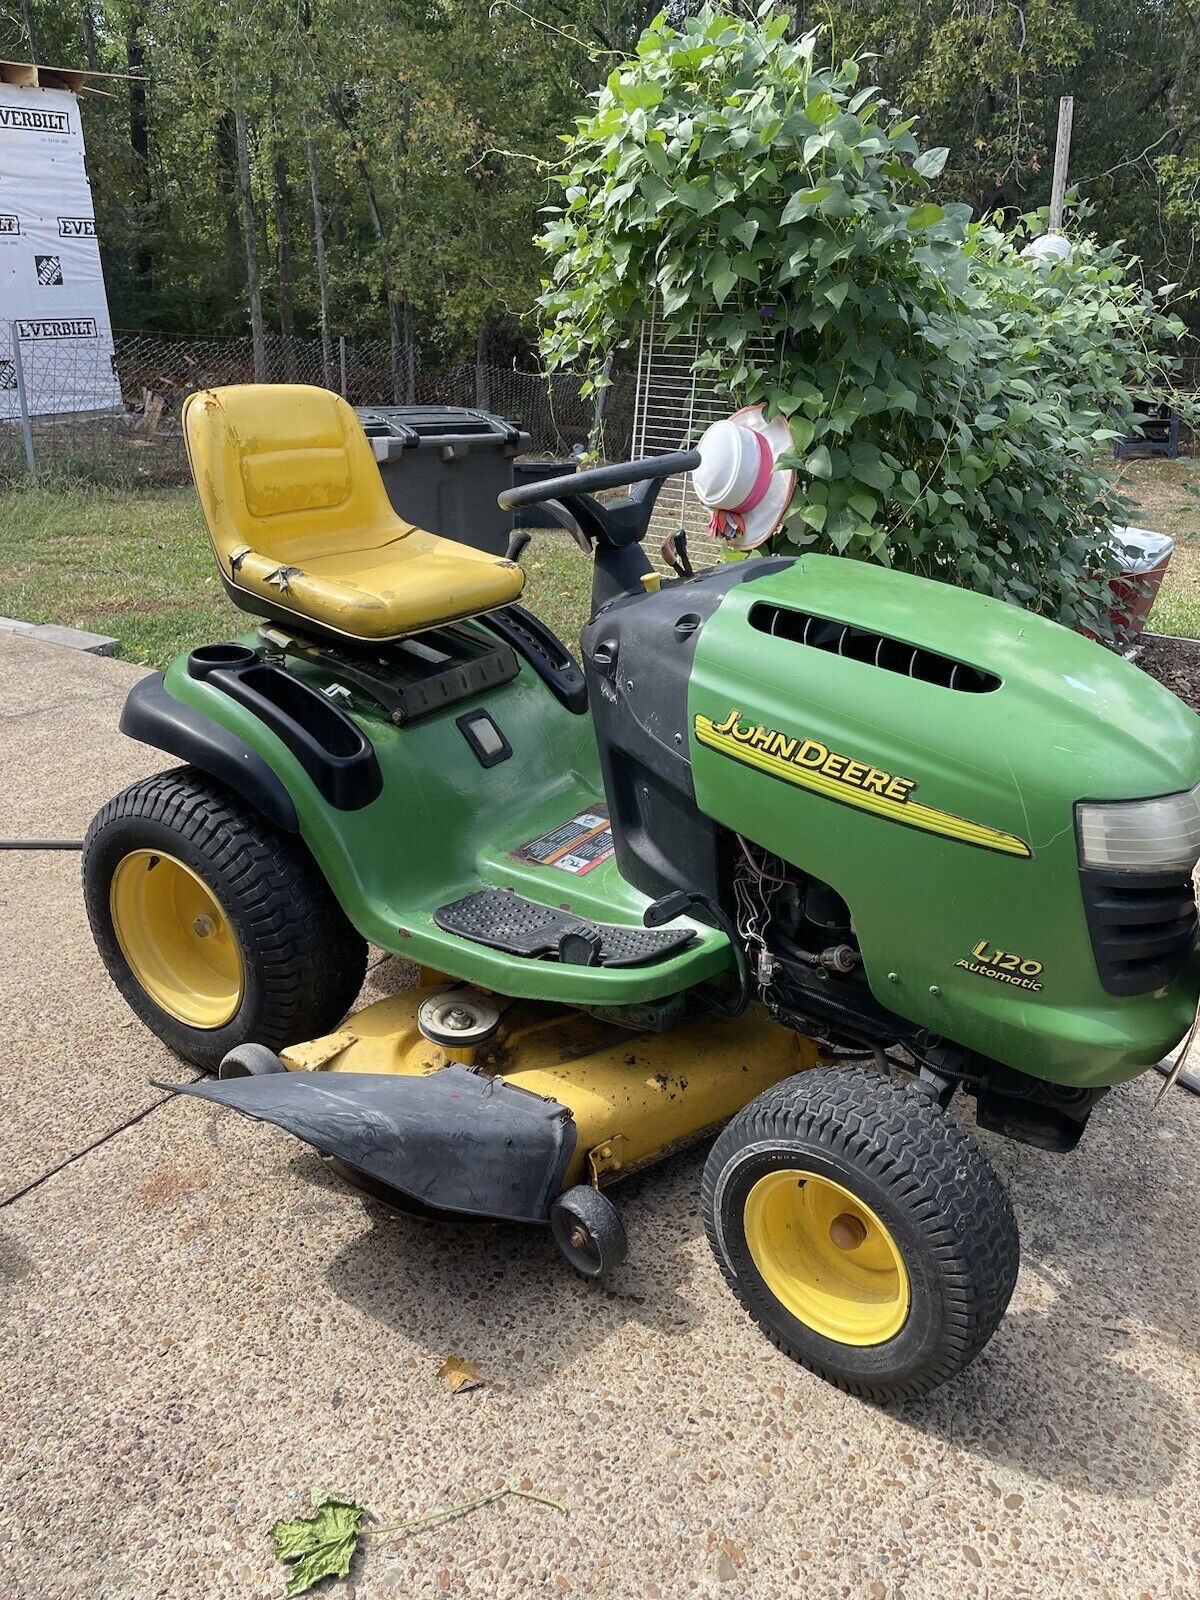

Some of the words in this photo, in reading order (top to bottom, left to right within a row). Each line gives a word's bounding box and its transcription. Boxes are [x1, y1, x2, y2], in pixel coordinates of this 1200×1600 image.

[61, 220, 95, 235] EVE
[38, 256, 60, 285] HOME
[18, 321, 92, 337] EVERBILT
[711, 709, 797, 759] JOHN
[794, 739, 916, 801] DEERE
[972, 940, 1043, 976] L120
[955, 959, 1043, 991] Automatic
